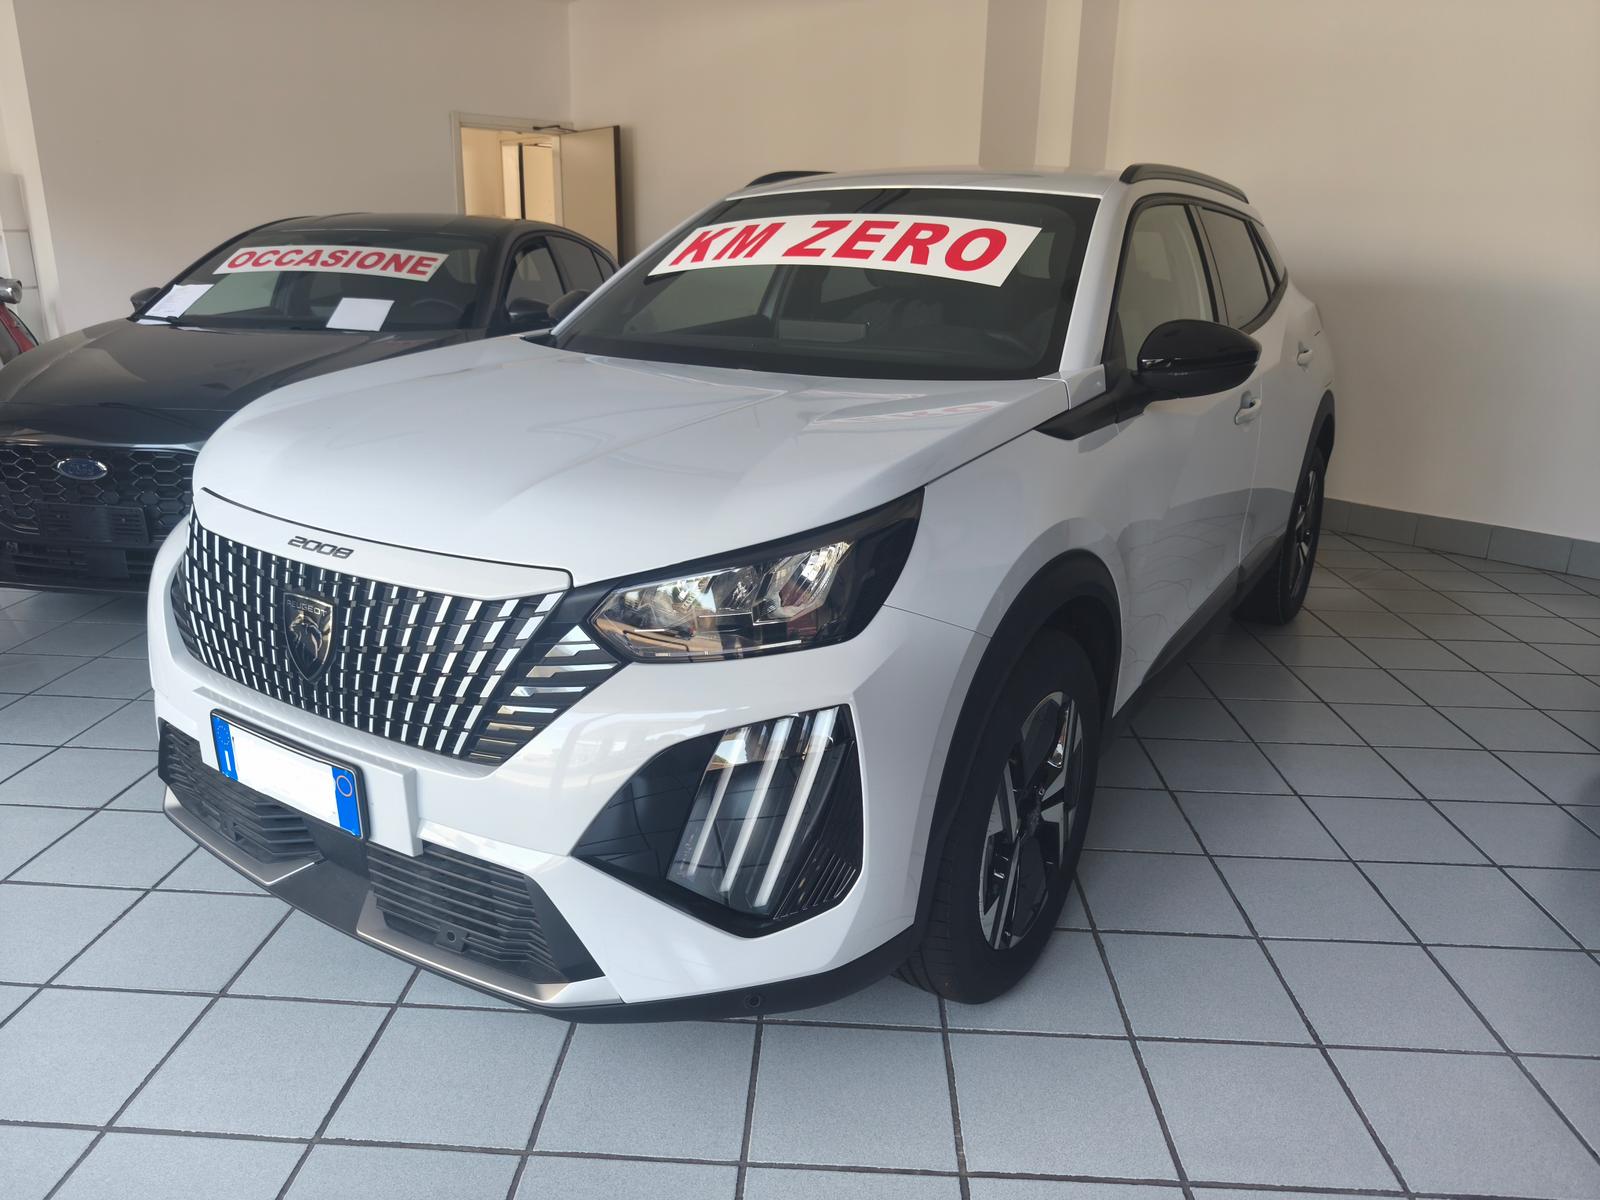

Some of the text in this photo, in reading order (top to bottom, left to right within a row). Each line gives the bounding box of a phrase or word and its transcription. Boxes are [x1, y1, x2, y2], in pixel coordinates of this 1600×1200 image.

[669, 220, 1007, 272] KM ZERO
[227, 249, 438, 276] OCCASIONE
[288, 535, 354, 559] 2008
[287, 599, 327, 617] PEUGEOT
